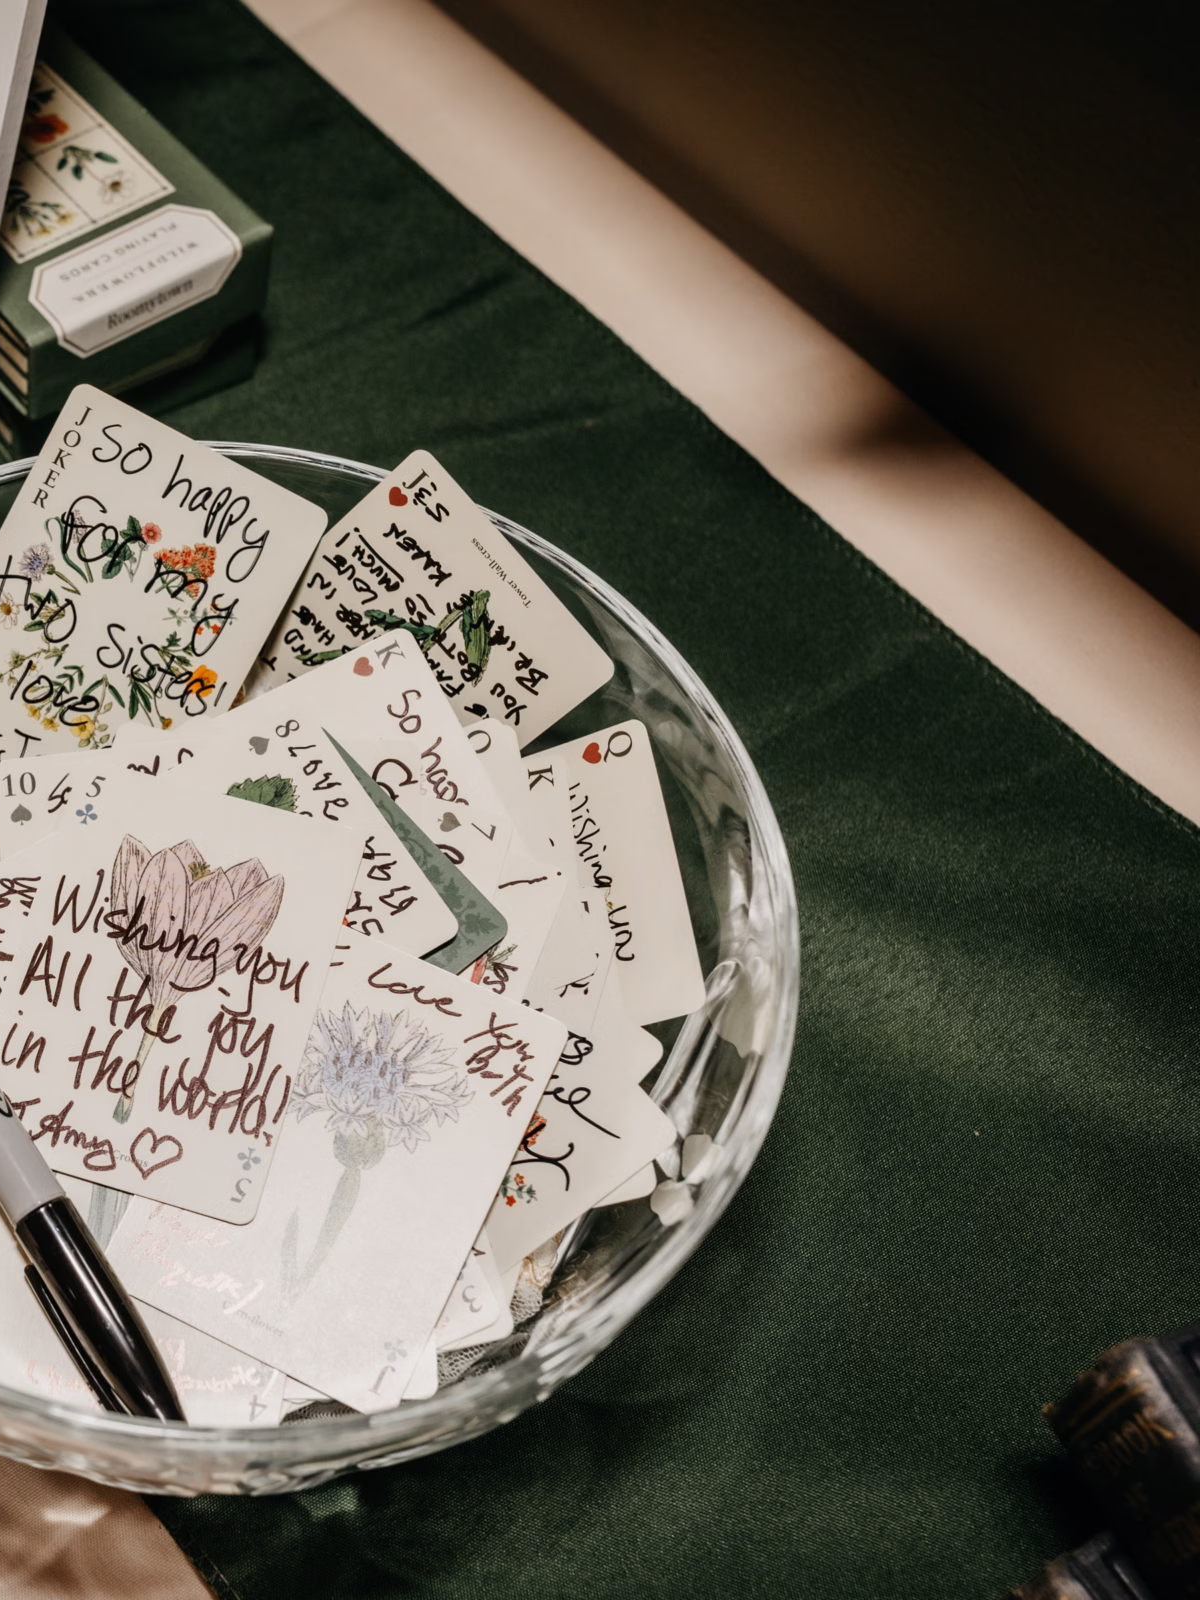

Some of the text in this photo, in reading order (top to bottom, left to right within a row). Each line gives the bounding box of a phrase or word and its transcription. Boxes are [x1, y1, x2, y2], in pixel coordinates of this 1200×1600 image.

[58, 221, 179, 282] PLAYING CARDS
[31, 406, 94, 509] JOKER
[401, 468, 430, 491] J
[91, 423, 271, 583] So happy
[61, 495, 240, 657] for my
[382, 522, 453, 588] KAREN
[470, 536, 533, 609] Tower Wall-cress
[306, 571, 338, 600] IN
[322, 553, 379, 605] LOVE
[404, 593, 437, 628] SO
[374, 640, 406, 670] K
[430, 630, 483, 683] BOTH
[470, 612, 549, 696] BRIAN
[10, 660, 100, 727] love
[386, 688, 423, 735] So
[489, 682, 528, 726] YOU
[274, 718, 301, 738] 8
[603, 730, 633, 764] Q
[2, 771, 38, 798] 10
[85, 775, 107, 798] 5
[527, 764, 555, 791] K
[470, 821, 498, 842] 7
[51, 868, 220, 993] Wishing
[221, 941, 310, 1018] you
[18, 935, 276, 1083] All the joy
[0, 1009, 48, 1074] in
[67, 1025, 141, 1099] the
[230, 1176, 253, 1204] 5
[248, 1394, 270, 1422] 4
